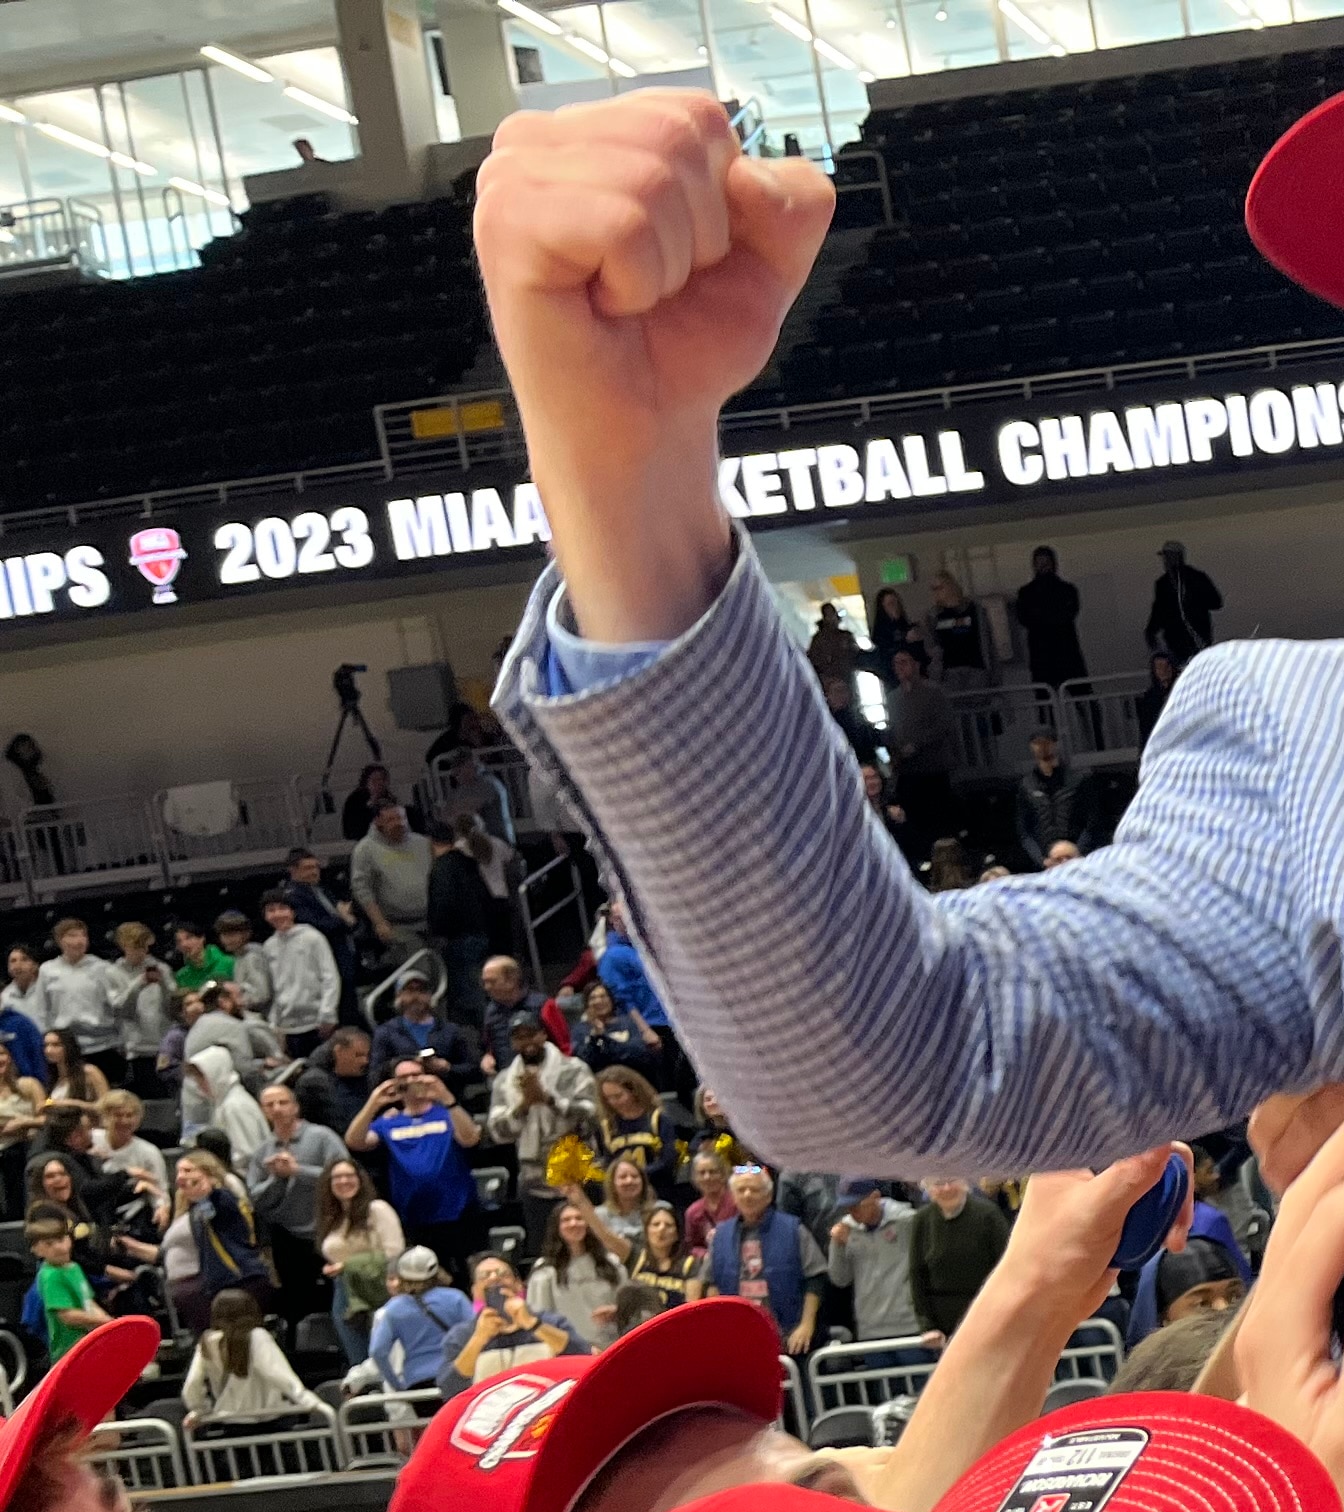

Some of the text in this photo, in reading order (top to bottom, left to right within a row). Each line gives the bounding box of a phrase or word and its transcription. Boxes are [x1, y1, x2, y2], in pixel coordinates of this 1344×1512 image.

[215, 507, 373, 583] 2023
[388, 482, 553, 559] MIAA
[717, 431, 984, 517] KETBALL
